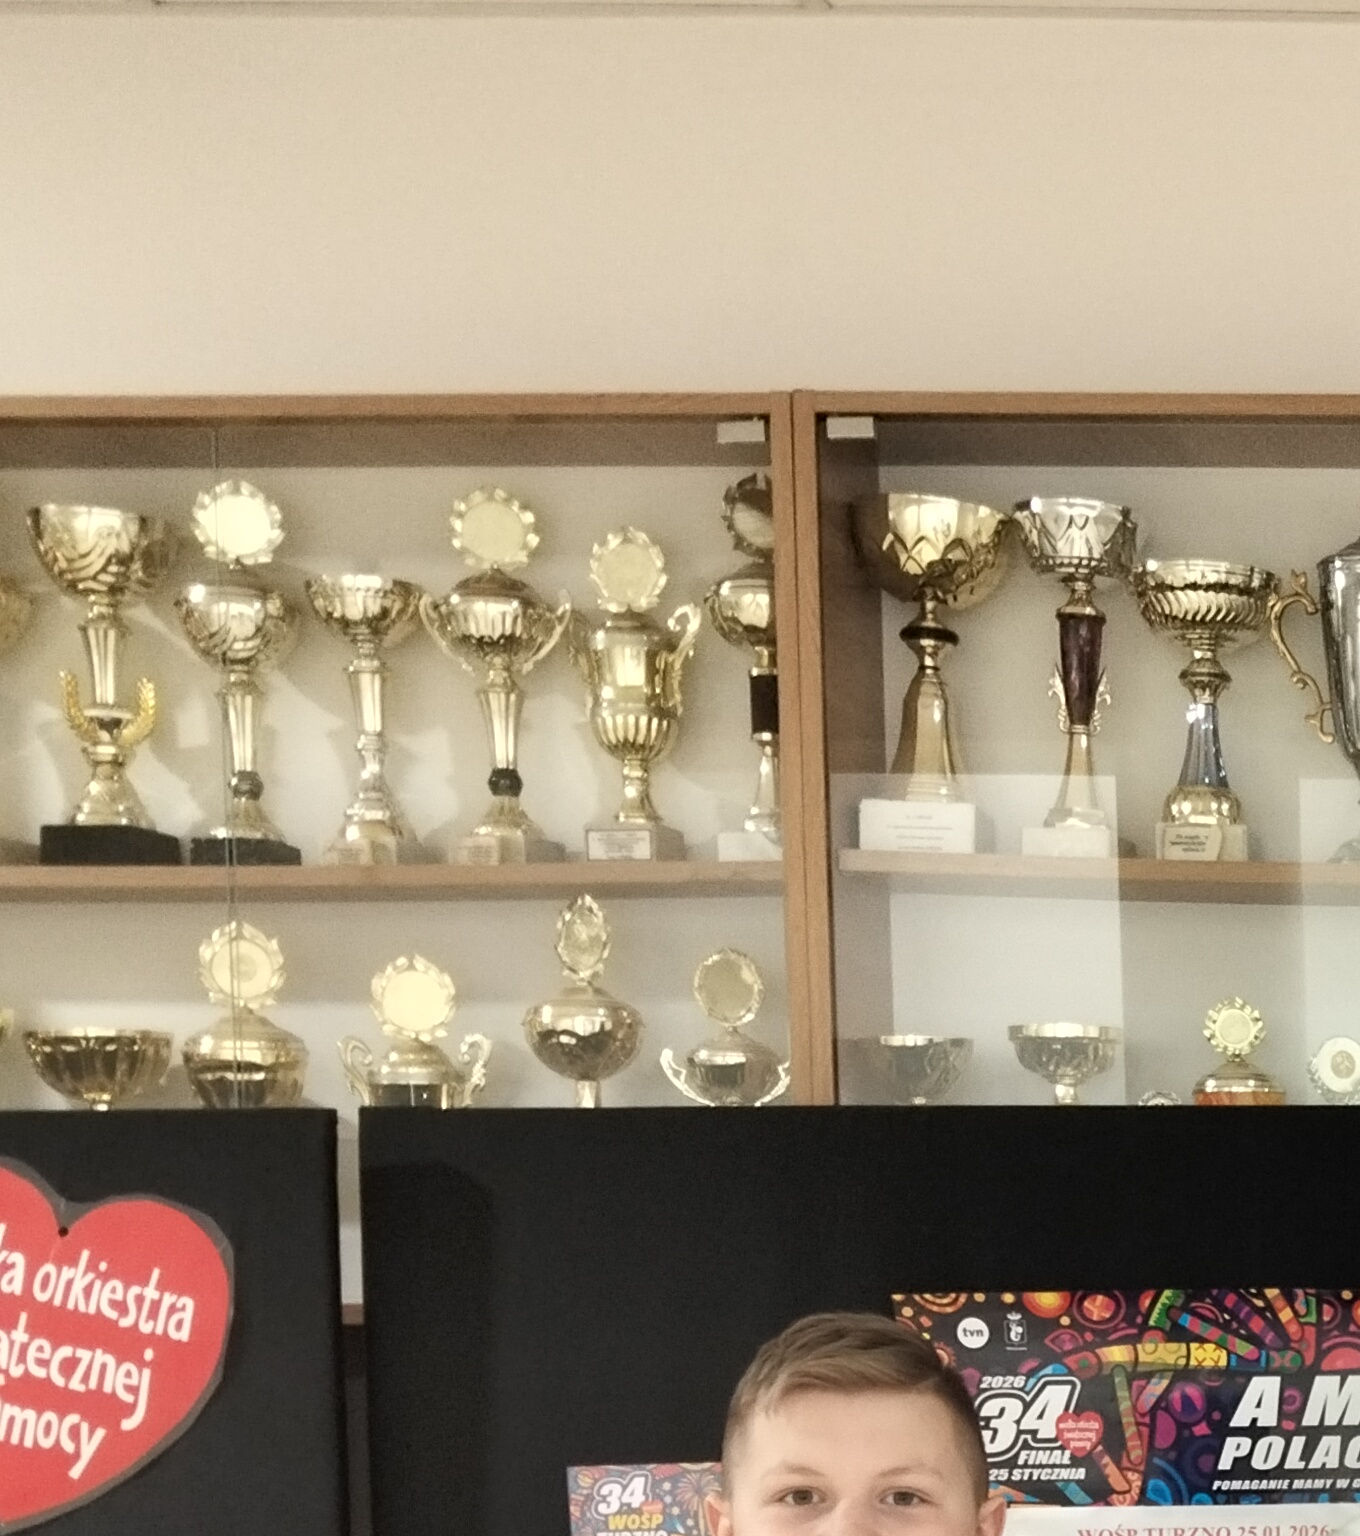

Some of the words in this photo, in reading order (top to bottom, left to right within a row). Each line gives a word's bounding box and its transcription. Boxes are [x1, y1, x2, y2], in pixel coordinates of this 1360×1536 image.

[33, 1249, 195, 1342] orkiestra
[962, 1326, 984, 1338] tvn
[980, 1376, 1027, 1389] 2026
[1229, 1376, 1281, 1427] A
[979, 1385, 1073, 1454] 34
[0, 1402, 106, 1480] mocy
[1017, 1450, 1072, 1465] FINAŁ
[989, 1468, 1009, 1481] 25
[1011, 1467, 1086, 1481] STYCZNIA
[1212, 1480, 1291, 1490] POMAGANIE
[1292, 1478, 1334, 1489] MAMY
[1336, 1478, 1351, 1489] W
[595, 1474, 648, 1516] 34
